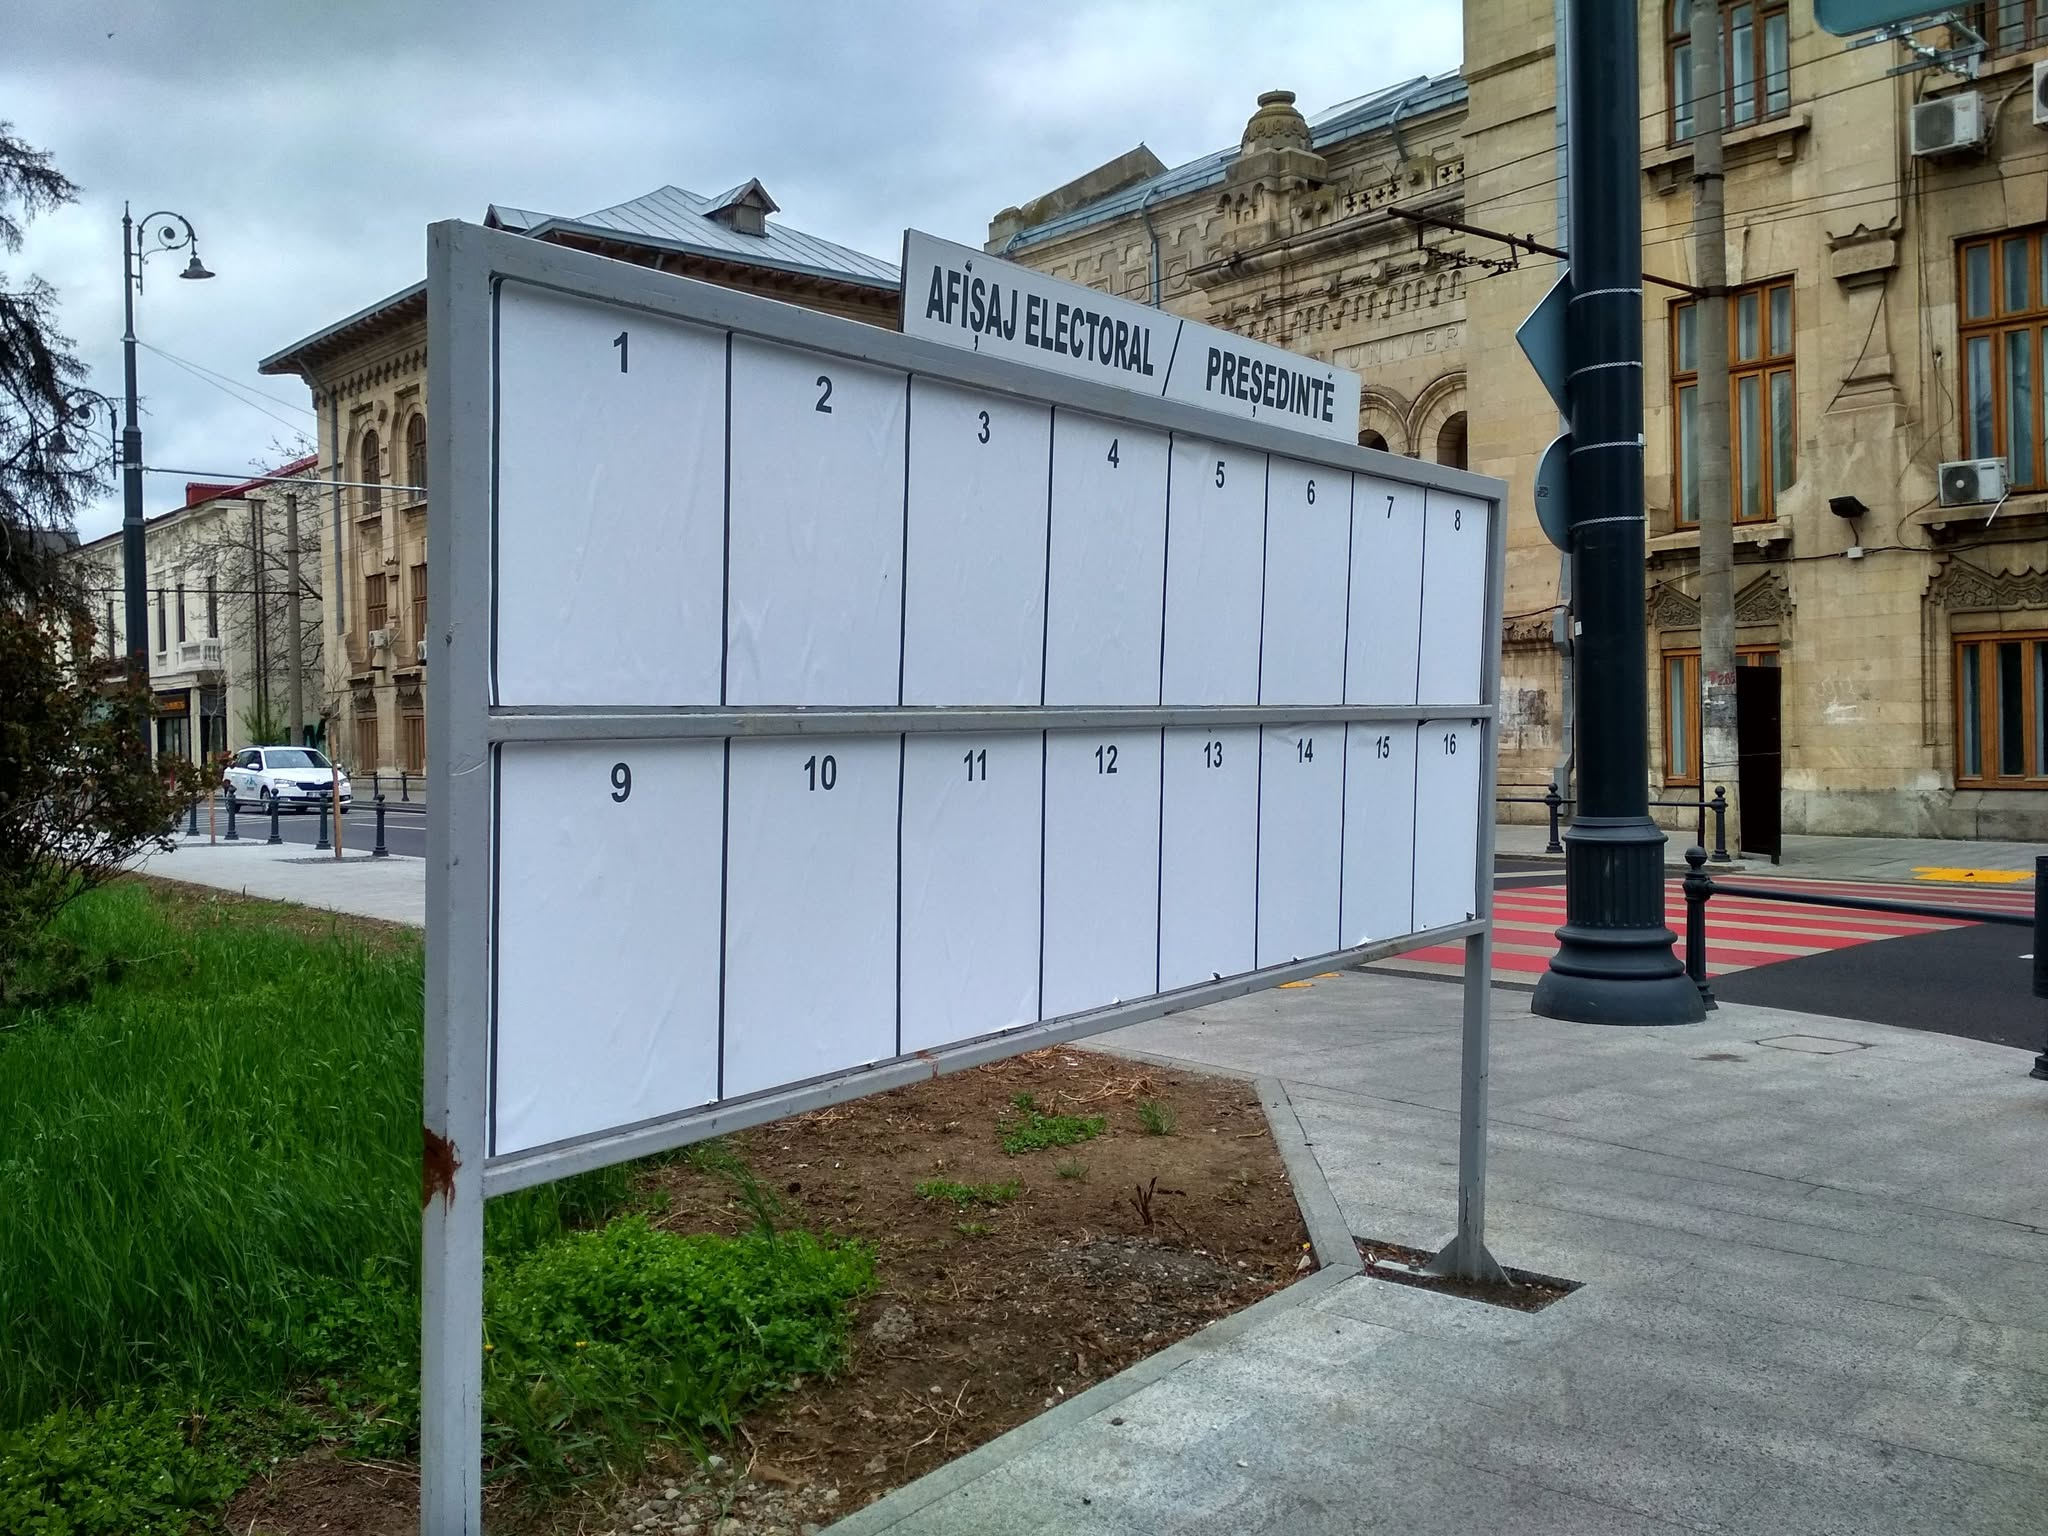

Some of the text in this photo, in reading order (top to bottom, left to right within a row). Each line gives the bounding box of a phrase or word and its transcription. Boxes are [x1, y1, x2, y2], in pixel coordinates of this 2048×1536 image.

[613, 331, 629, 374] 1
[926, 265, 1018, 351] AFIȘAJ
[1025, 294, 1153, 376] ELECTORAL
[1206, 347, 1335, 423] PREȘEDINTE
[815, 375, 833, 414] 2
[977, 410, 992, 445] 3
[1106, 438, 1120, 470] 4
[1215, 460, 1227, 490] 5
[1305, 479, 1316, 505] 6
[1386, 495, 1396, 520] 7
[1454, 509, 1462, 532] 8
[1095, 744, 1119, 775] 12
[1203, 741, 1223, 770] 13
[1296, 738, 1314, 764] 14
[1376, 735, 1391, 760] 15
[1443, 733, 1457, 756] 16
[804, 754, 837, 793] 10
[963, 748, 987, 783] 11
[610, 762, 632, 804] 9
